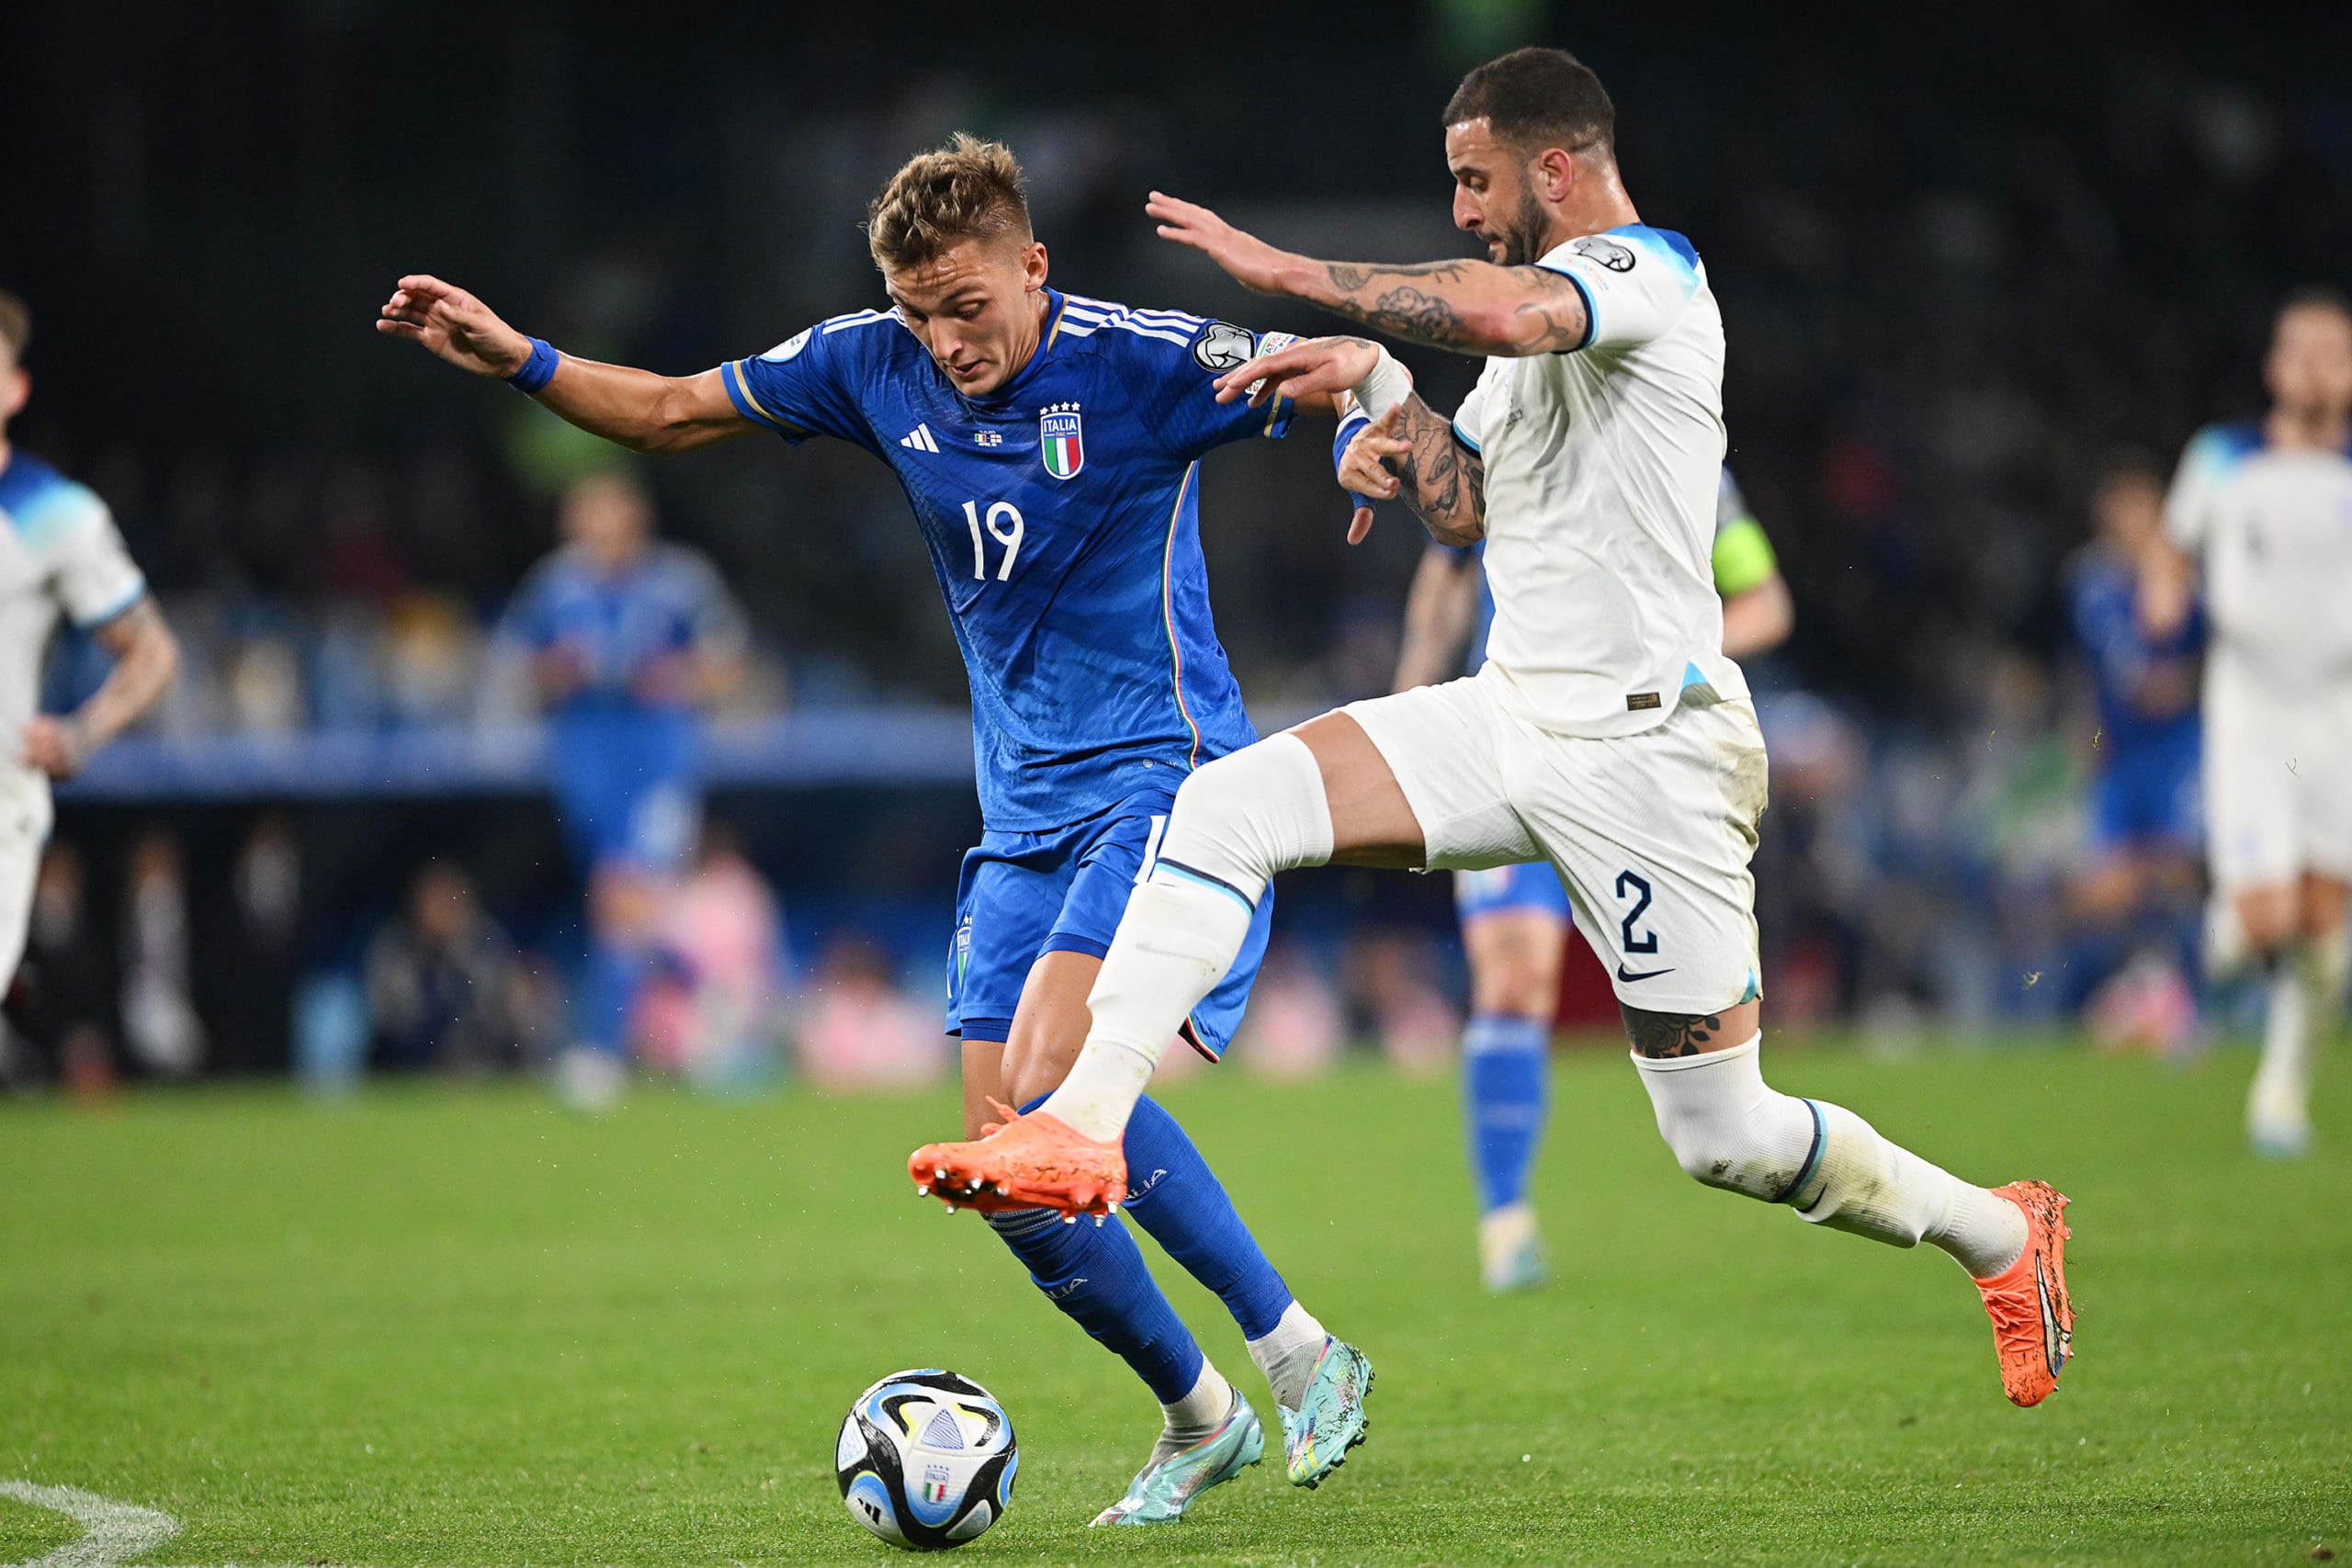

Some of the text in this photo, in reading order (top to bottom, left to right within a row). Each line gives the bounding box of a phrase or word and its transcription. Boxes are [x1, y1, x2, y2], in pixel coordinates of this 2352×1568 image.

[1044, 418, 1077, 432] ITALIA
[961, 499, 1024, 581] 19
[1616, 869, 1657, 953] 2
